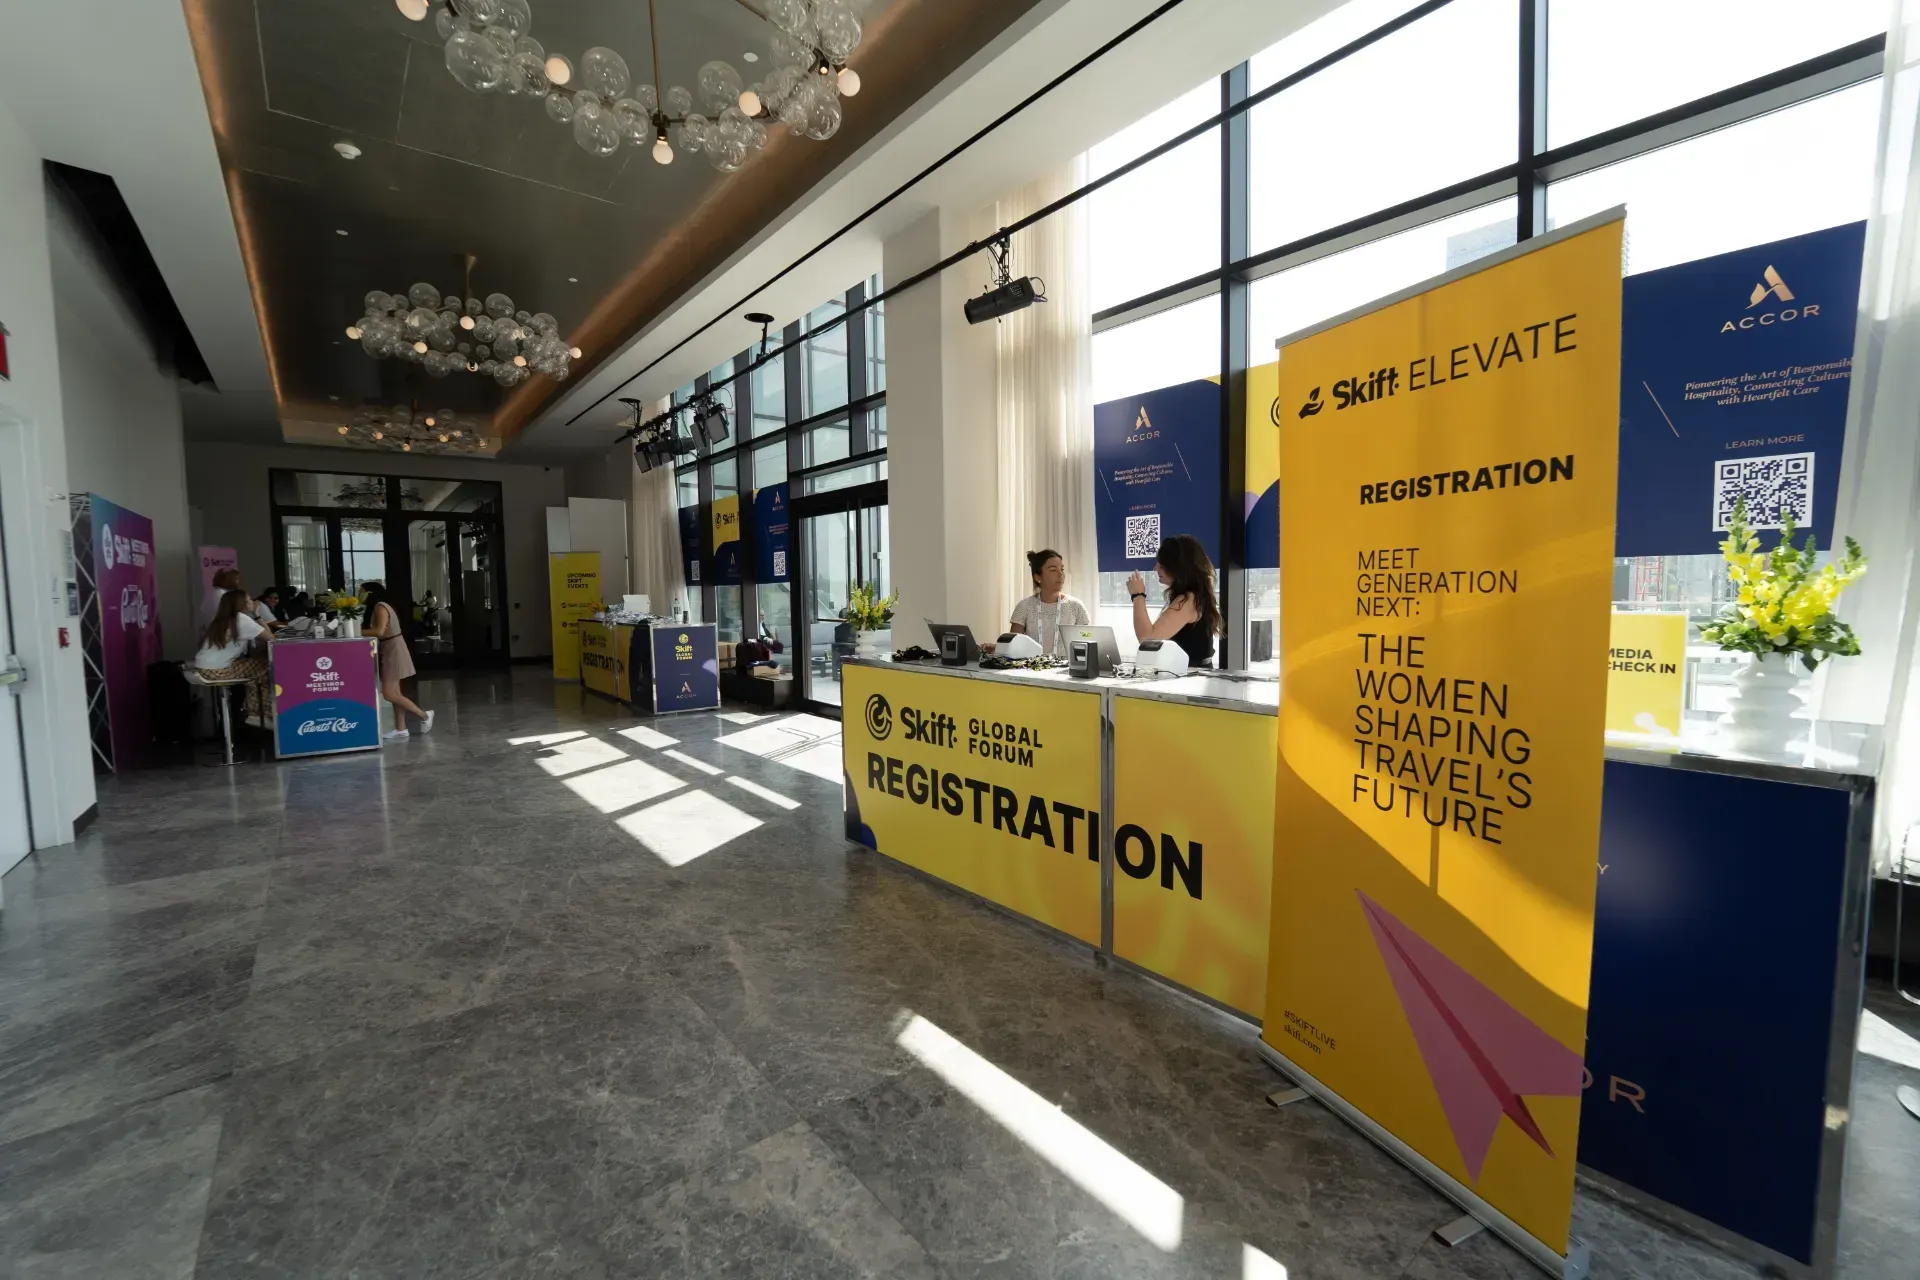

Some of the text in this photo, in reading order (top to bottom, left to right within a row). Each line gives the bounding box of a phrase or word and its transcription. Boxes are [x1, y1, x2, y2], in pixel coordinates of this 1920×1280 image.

[1720, 304, 1820, 333] ACCOR
[1409, 313, 1577, 392] ELEVATE
[1684, 386, 1741, 401] Hospitality,
[1744, 377, 1805, 392] Connecting
[1685, 376, 1738, 390] Pioneering
[1740, 373, 1757, 383] the
[1759, 370, 1777, 380] Art
[1779, 366, 1793, 378] of
[1716, 385, 1820, 406] with Heartfelt Care
[1126, 431, 1160, 444] ACCOR
[1725, 434, 1805, 450] LEARN MORE
[1359, 454, 1575, 505] REGISTRATION
[1358, 548, 1420, 570] MEET
[1357, 570, 1518, 594] GENERATION
[1356, 597, 1420, 617] NEXT:
[1358, 633, 1425, 668] THE
[1660, 663, 1676, 674] IN
[1356, 668, 1508, 719] WOMEN
[297, 718, 359, 736] Puerto Rico
[969, 718, 1043, 748] GLOBAL
[1355, 704, 1531, 765] SHAPING
[969, 738, 1033, 768] FORUM
[1354, 738, 1532, 809] TRAVEL'S
[1353, 773, 1504, 845] FUTURE
[867, 751, 1203, 901] REGISTRATION
[1283, 1024, 1321, 1055] skift.com
[1284, 1009, 1336, 1050] #SKIFTLIVE
